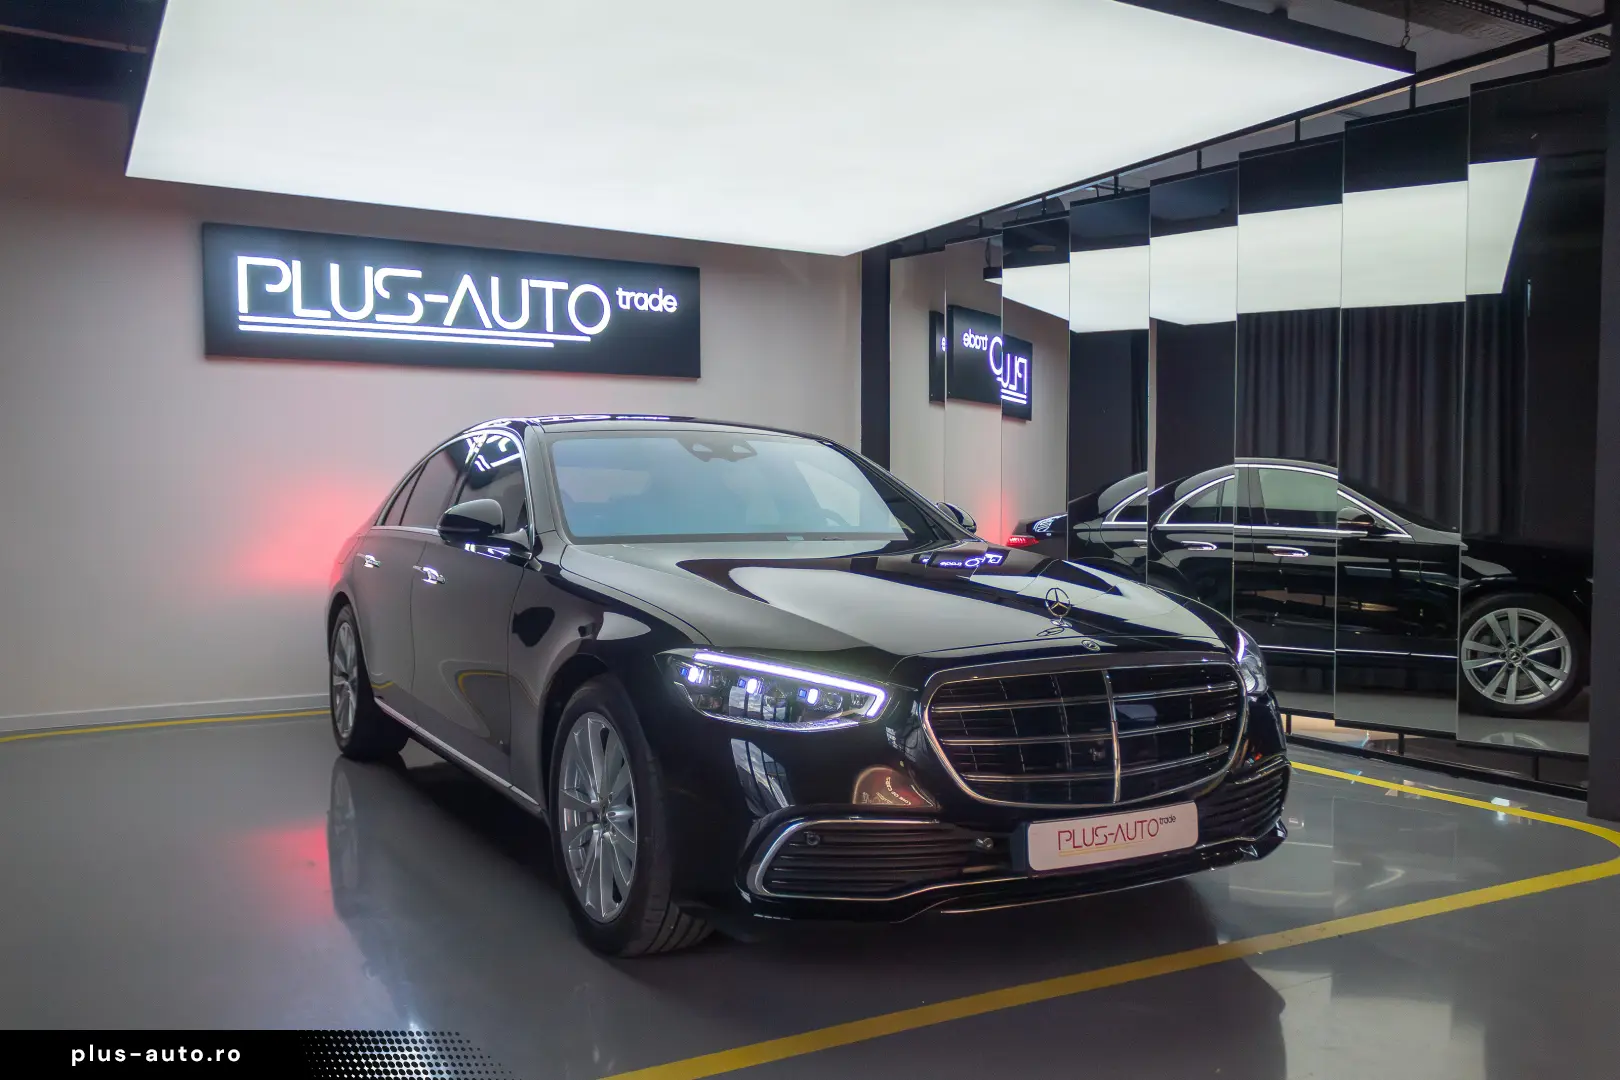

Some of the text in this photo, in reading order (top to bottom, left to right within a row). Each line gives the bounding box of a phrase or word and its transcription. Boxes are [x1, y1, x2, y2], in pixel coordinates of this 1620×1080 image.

[237, 255, 678, 336] PLUS-AUTO trade
[1057, 814, 1177, 851] PLUS-AUTO trade
